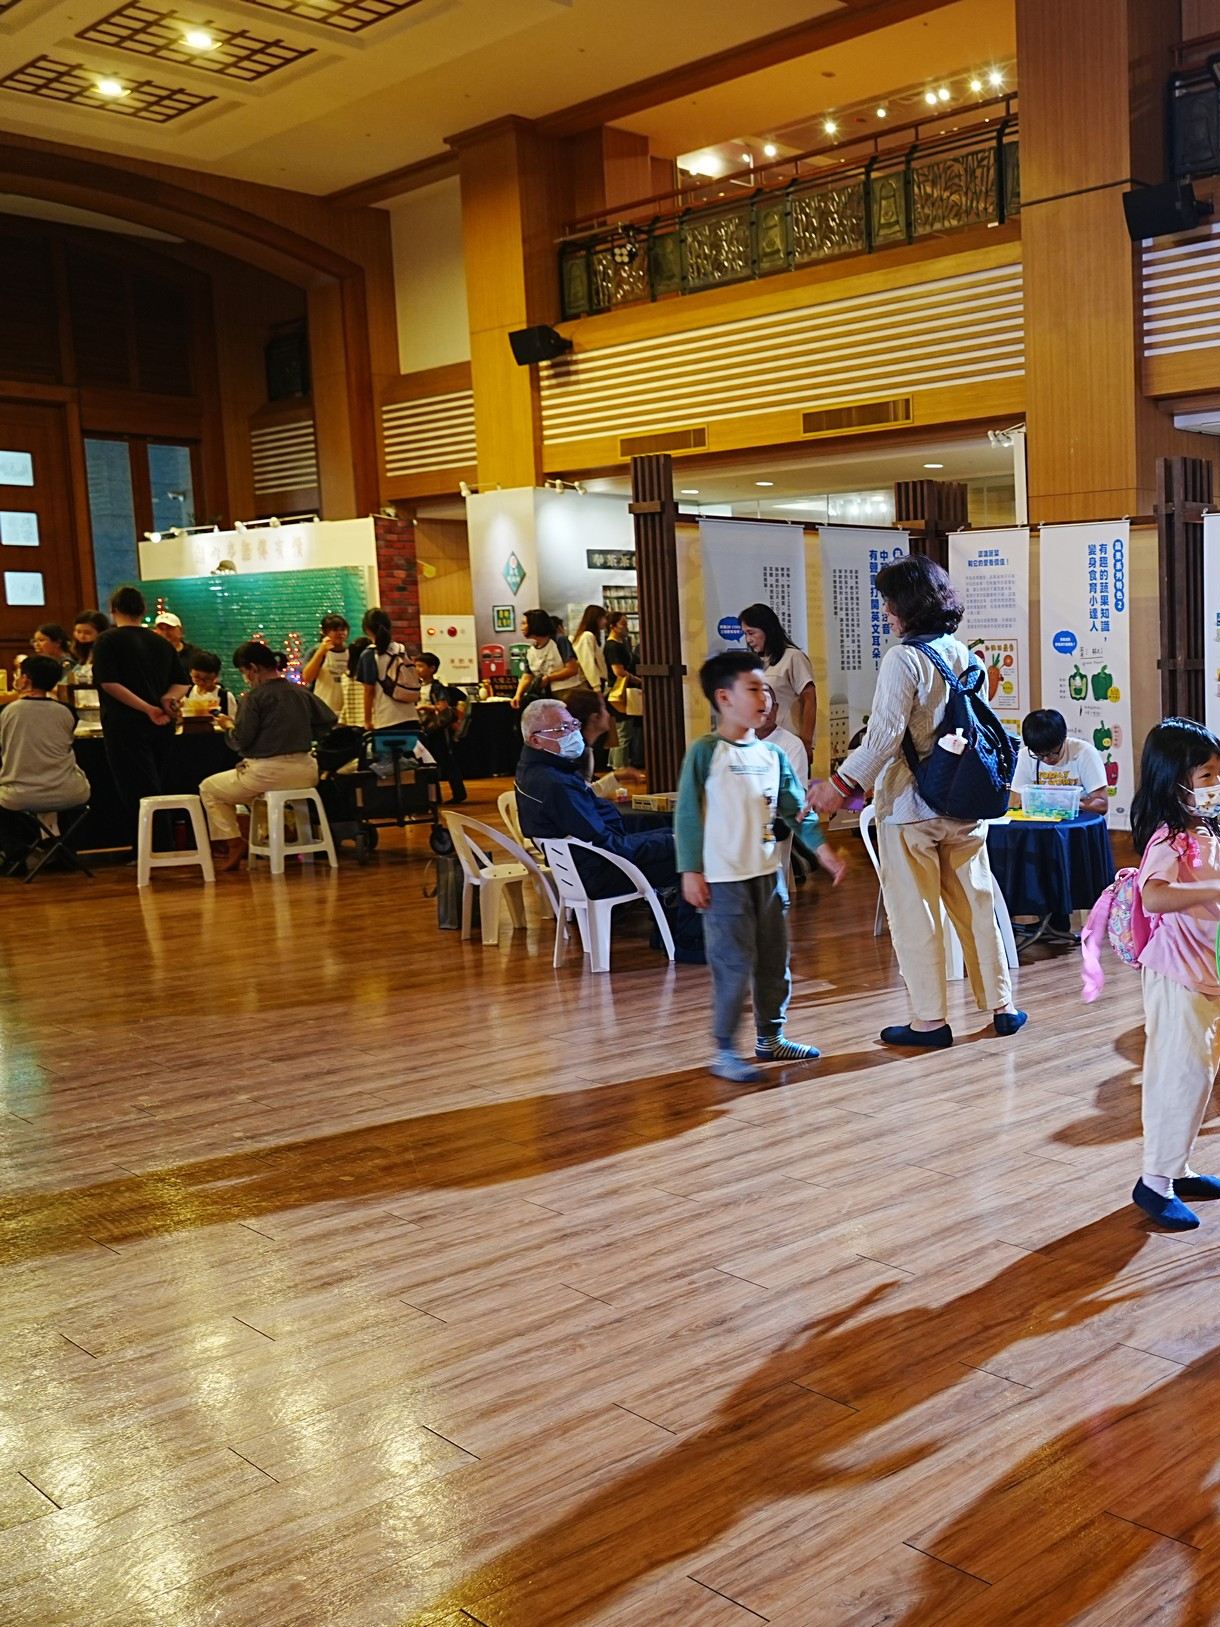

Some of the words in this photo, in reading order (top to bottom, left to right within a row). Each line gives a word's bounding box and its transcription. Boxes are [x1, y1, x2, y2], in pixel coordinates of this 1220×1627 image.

[1088, 544, 1098, 632] 變身食育小達人
